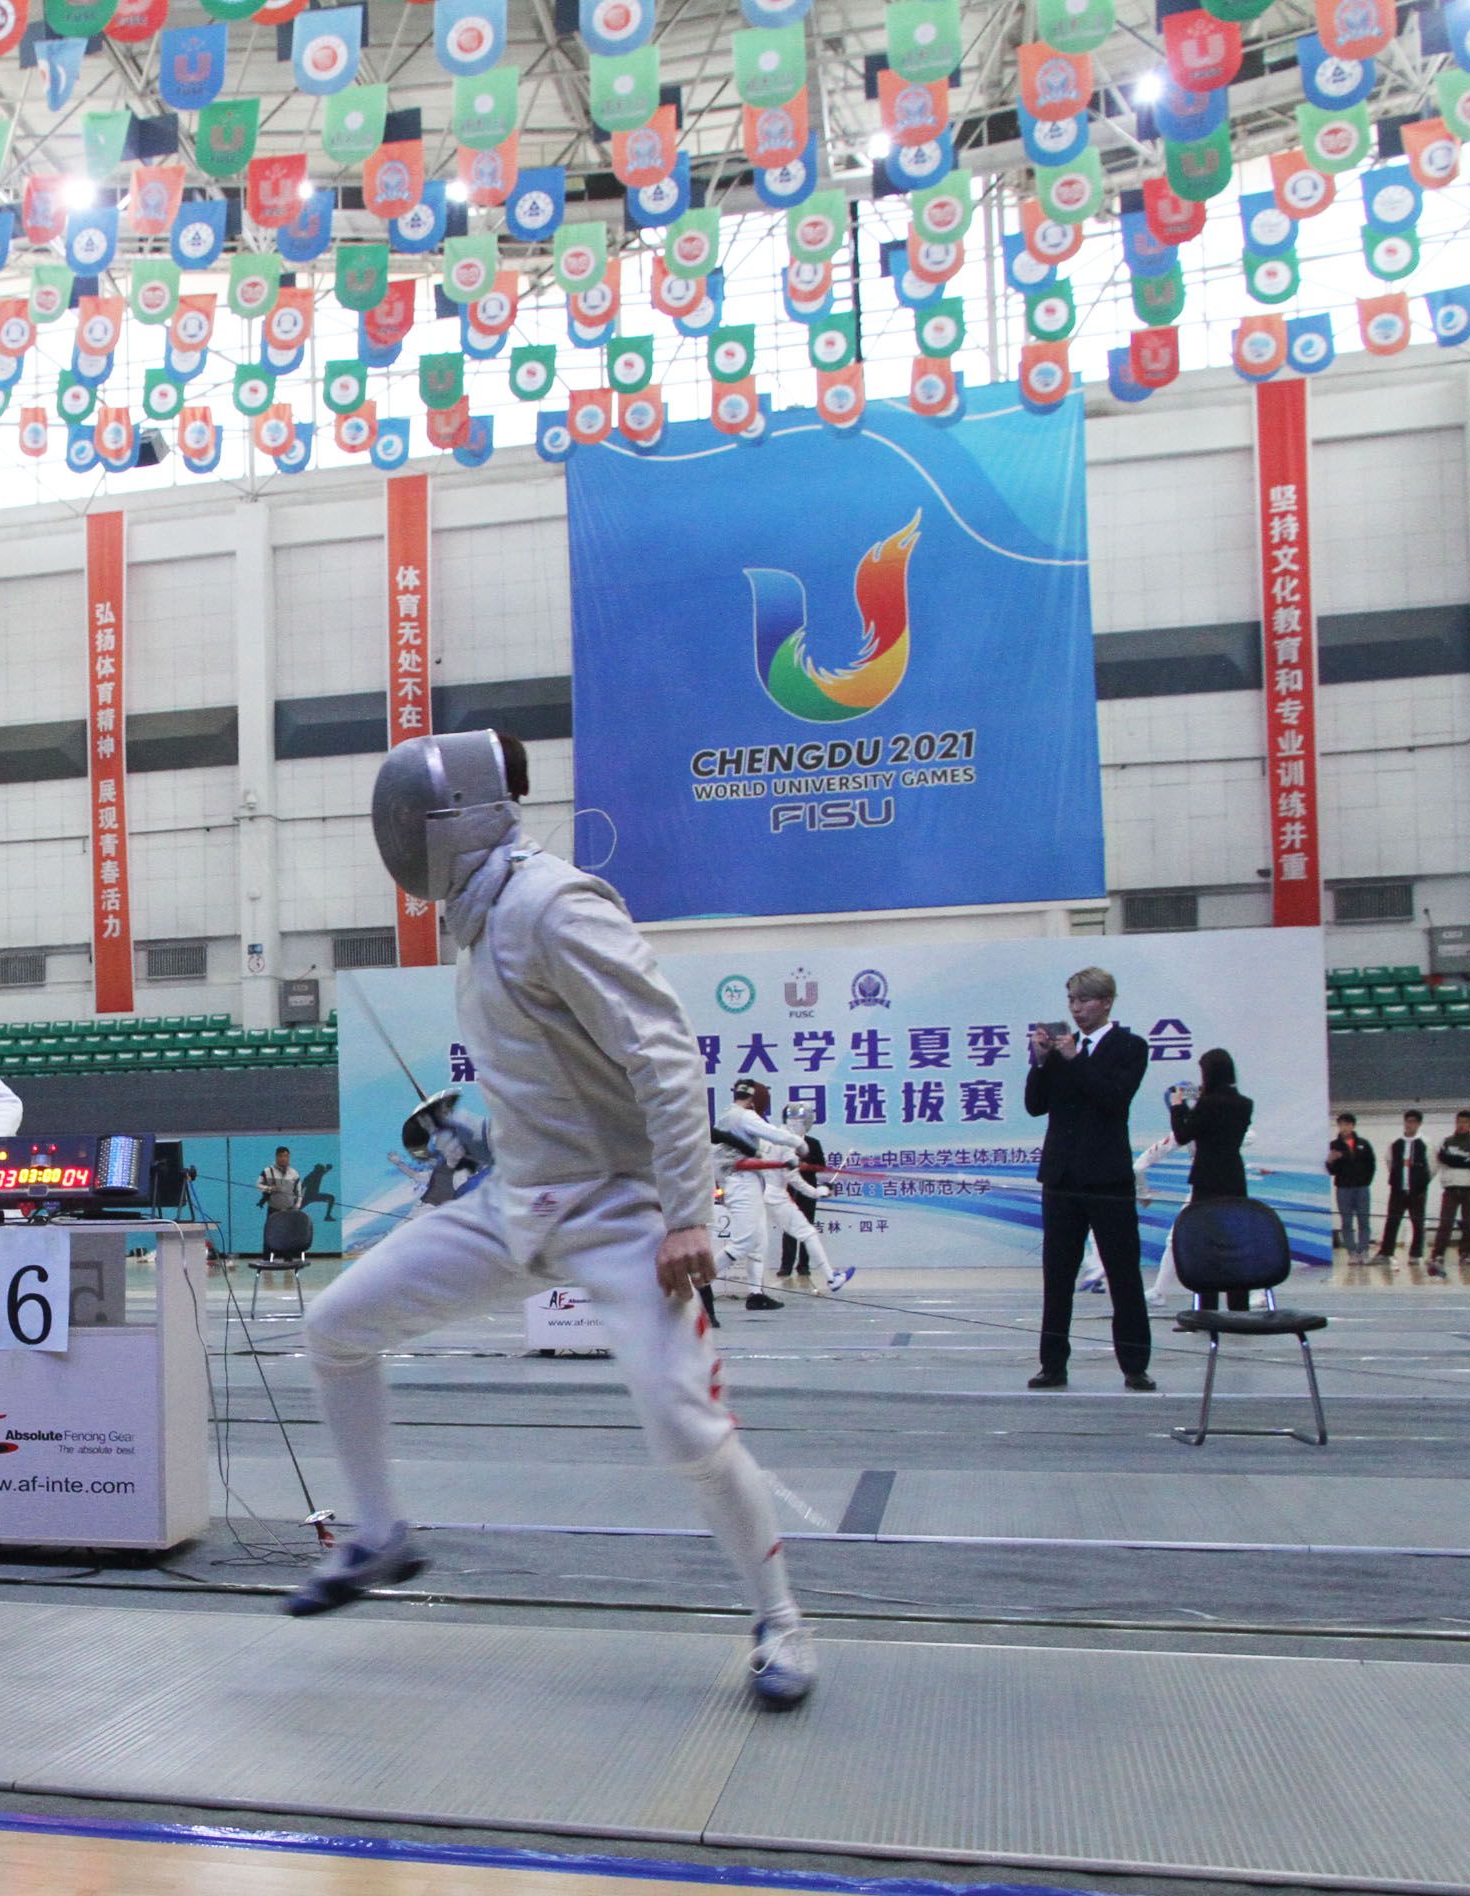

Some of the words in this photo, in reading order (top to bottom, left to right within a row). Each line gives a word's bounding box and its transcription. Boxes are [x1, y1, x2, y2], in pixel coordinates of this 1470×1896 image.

[395, 566, 424, 730] 体育无处不在
[95, 601, 116, 760] 弘扬体育精神
[1269, 484, 1309, 881] 坚持文化教育和专业训练并重
[690, 738, 881, 776] CHENGDU
[889, 729, 977, 766] 2021
[692, 780, 765, 801] WORLD
[772, 772, 894, 795] UNIVERSITY
[901, 766, 975, 787] GAMES
[769, 798, 895, 833] FISU
[98, 779, 122, 939] 展现青春活力
[18, 1168, 61, 1183] 03:00
[62, 1168, 89, 1187] 04
[718, 1215, 731, 1238] 2
[6, 1264, 53, 1345] 6
[549, 1290, 568, 1308] AF
[5, 1430, 63, 1441] Absolute
[64, 1430, 105, 1444] Fencing
[108, 1430, 135, 1442] Gear
[59, 1444, 74, 1453] The
[78, 1444, 112, 1454] absolute
[116, 1445, 135, 1454] best
